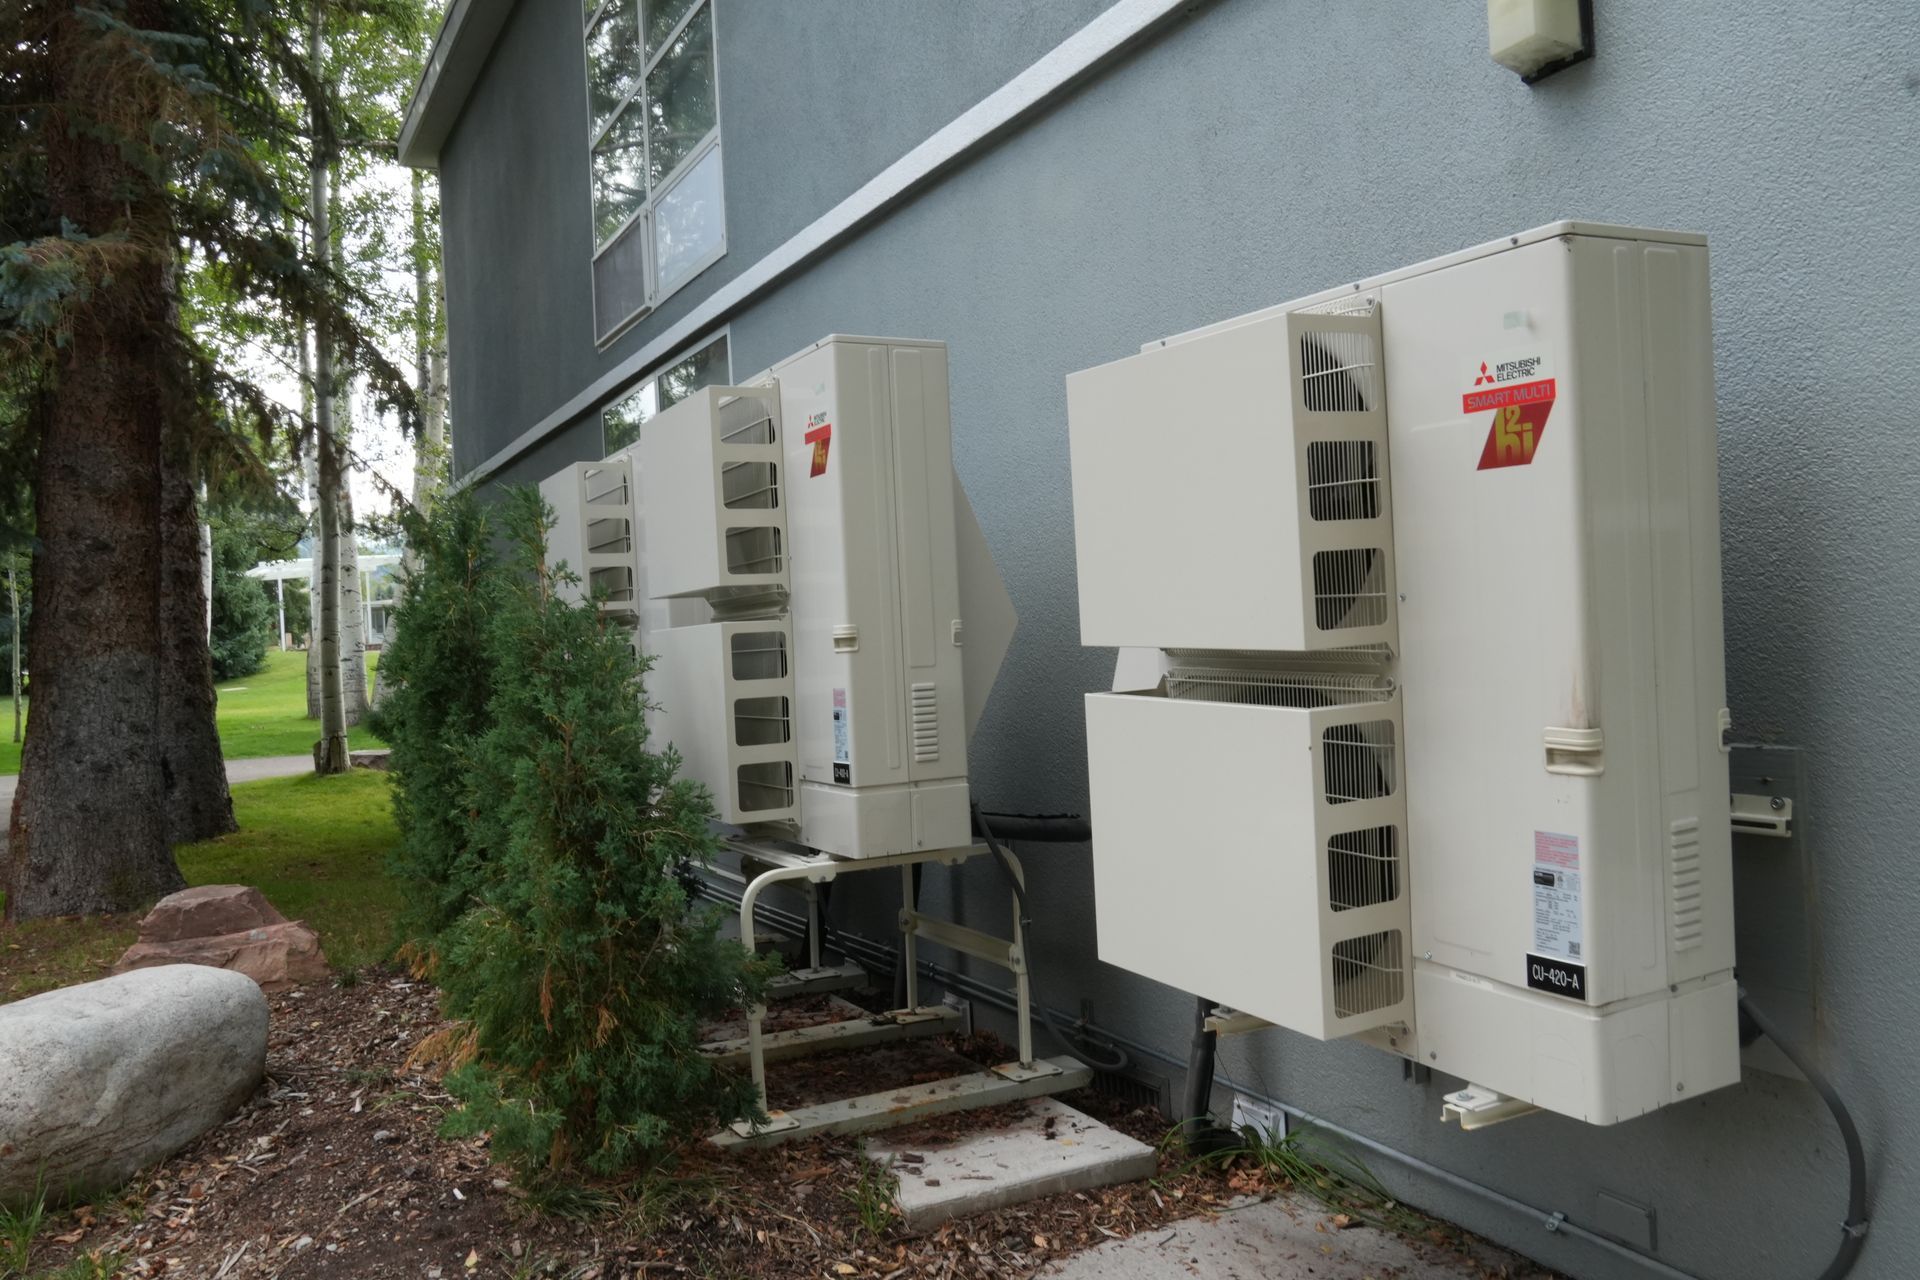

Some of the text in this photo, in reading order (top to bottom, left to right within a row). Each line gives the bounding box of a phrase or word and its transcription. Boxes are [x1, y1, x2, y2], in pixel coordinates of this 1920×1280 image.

[1496, 357, 1541, 373] MITSUBISHI
[1497, 367, 1535, 382] ELECTRIC
[1467, 384, 1551, 409] SMART MULTI
[1532, 964, 1580, 990] CU-420-A
